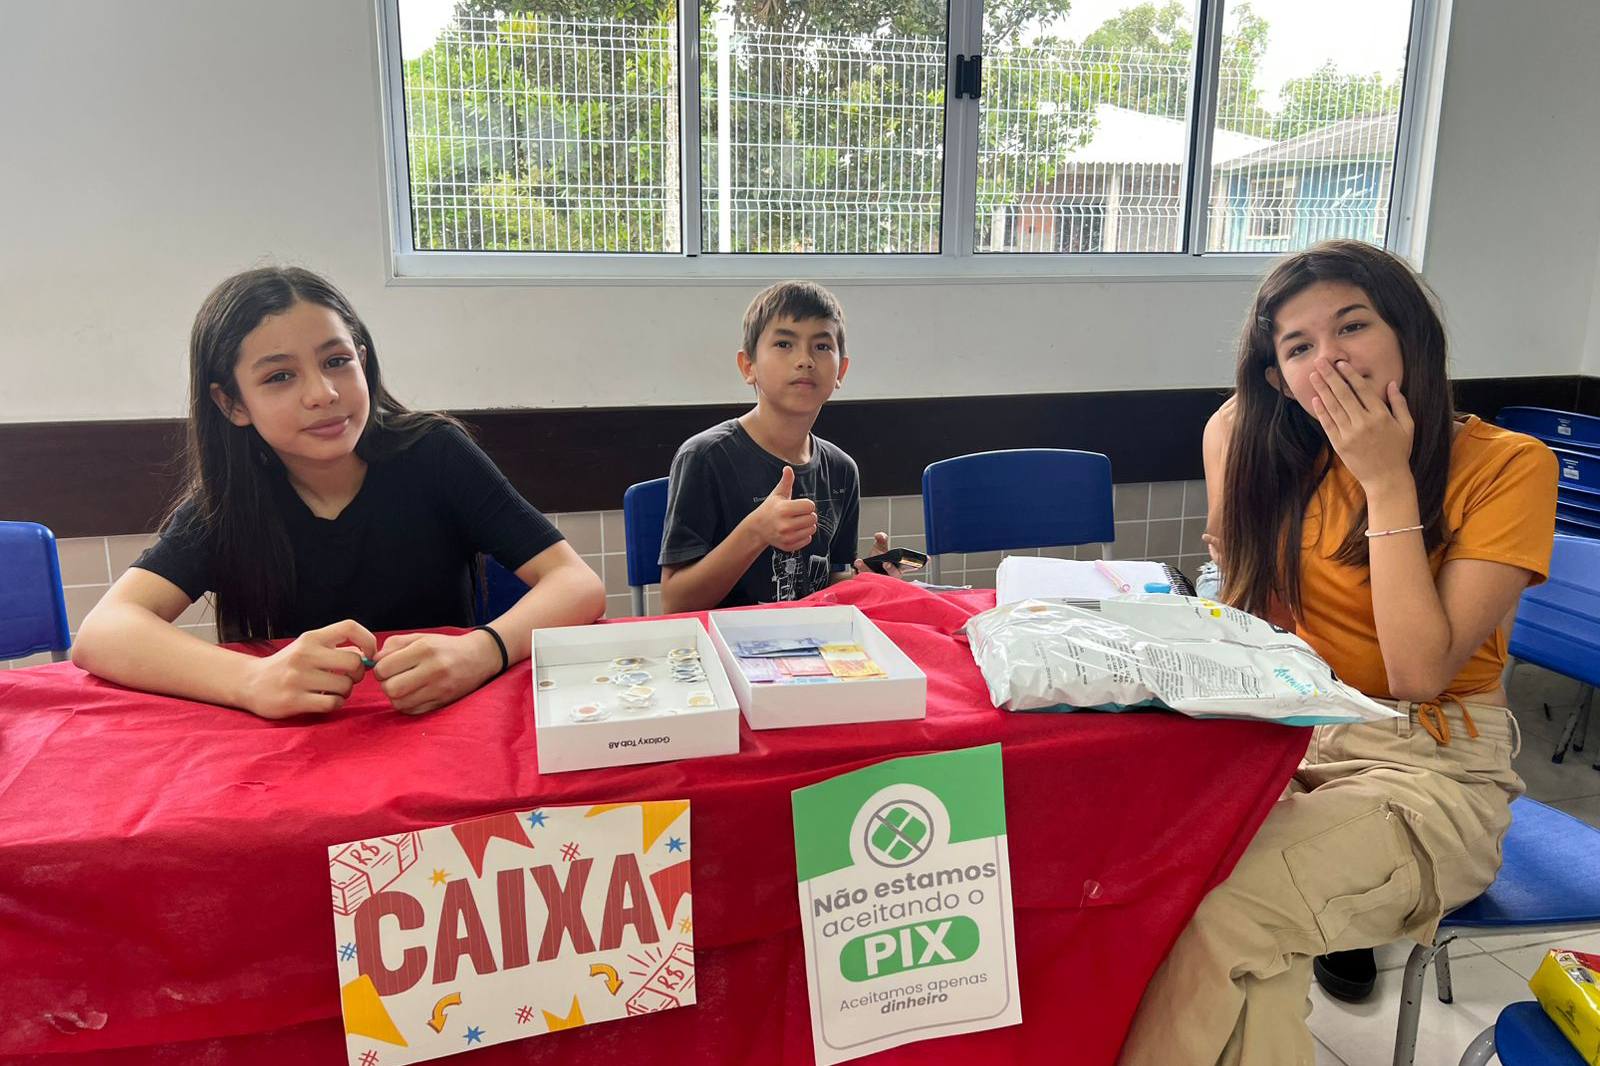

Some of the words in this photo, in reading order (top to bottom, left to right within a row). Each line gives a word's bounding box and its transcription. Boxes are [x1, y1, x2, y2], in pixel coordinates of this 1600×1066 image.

[608, 741, 620, 749] A8
[638, 736, 670, 745] Galaxy
[813, 888, 868, 917] Não
[874, 862, 996, 898] estamos
[354, 853, 660, 997] CAIXA
[822, 891, 960, 938] aceitando
[968, 889, 985, 905] o
[864, 921, 956, 976] PIX
[839, 983, 923, 1012] Aceitamos
[927, 973, 988, 993] apenas
[880, 993, 949, 1015] dinheiro
